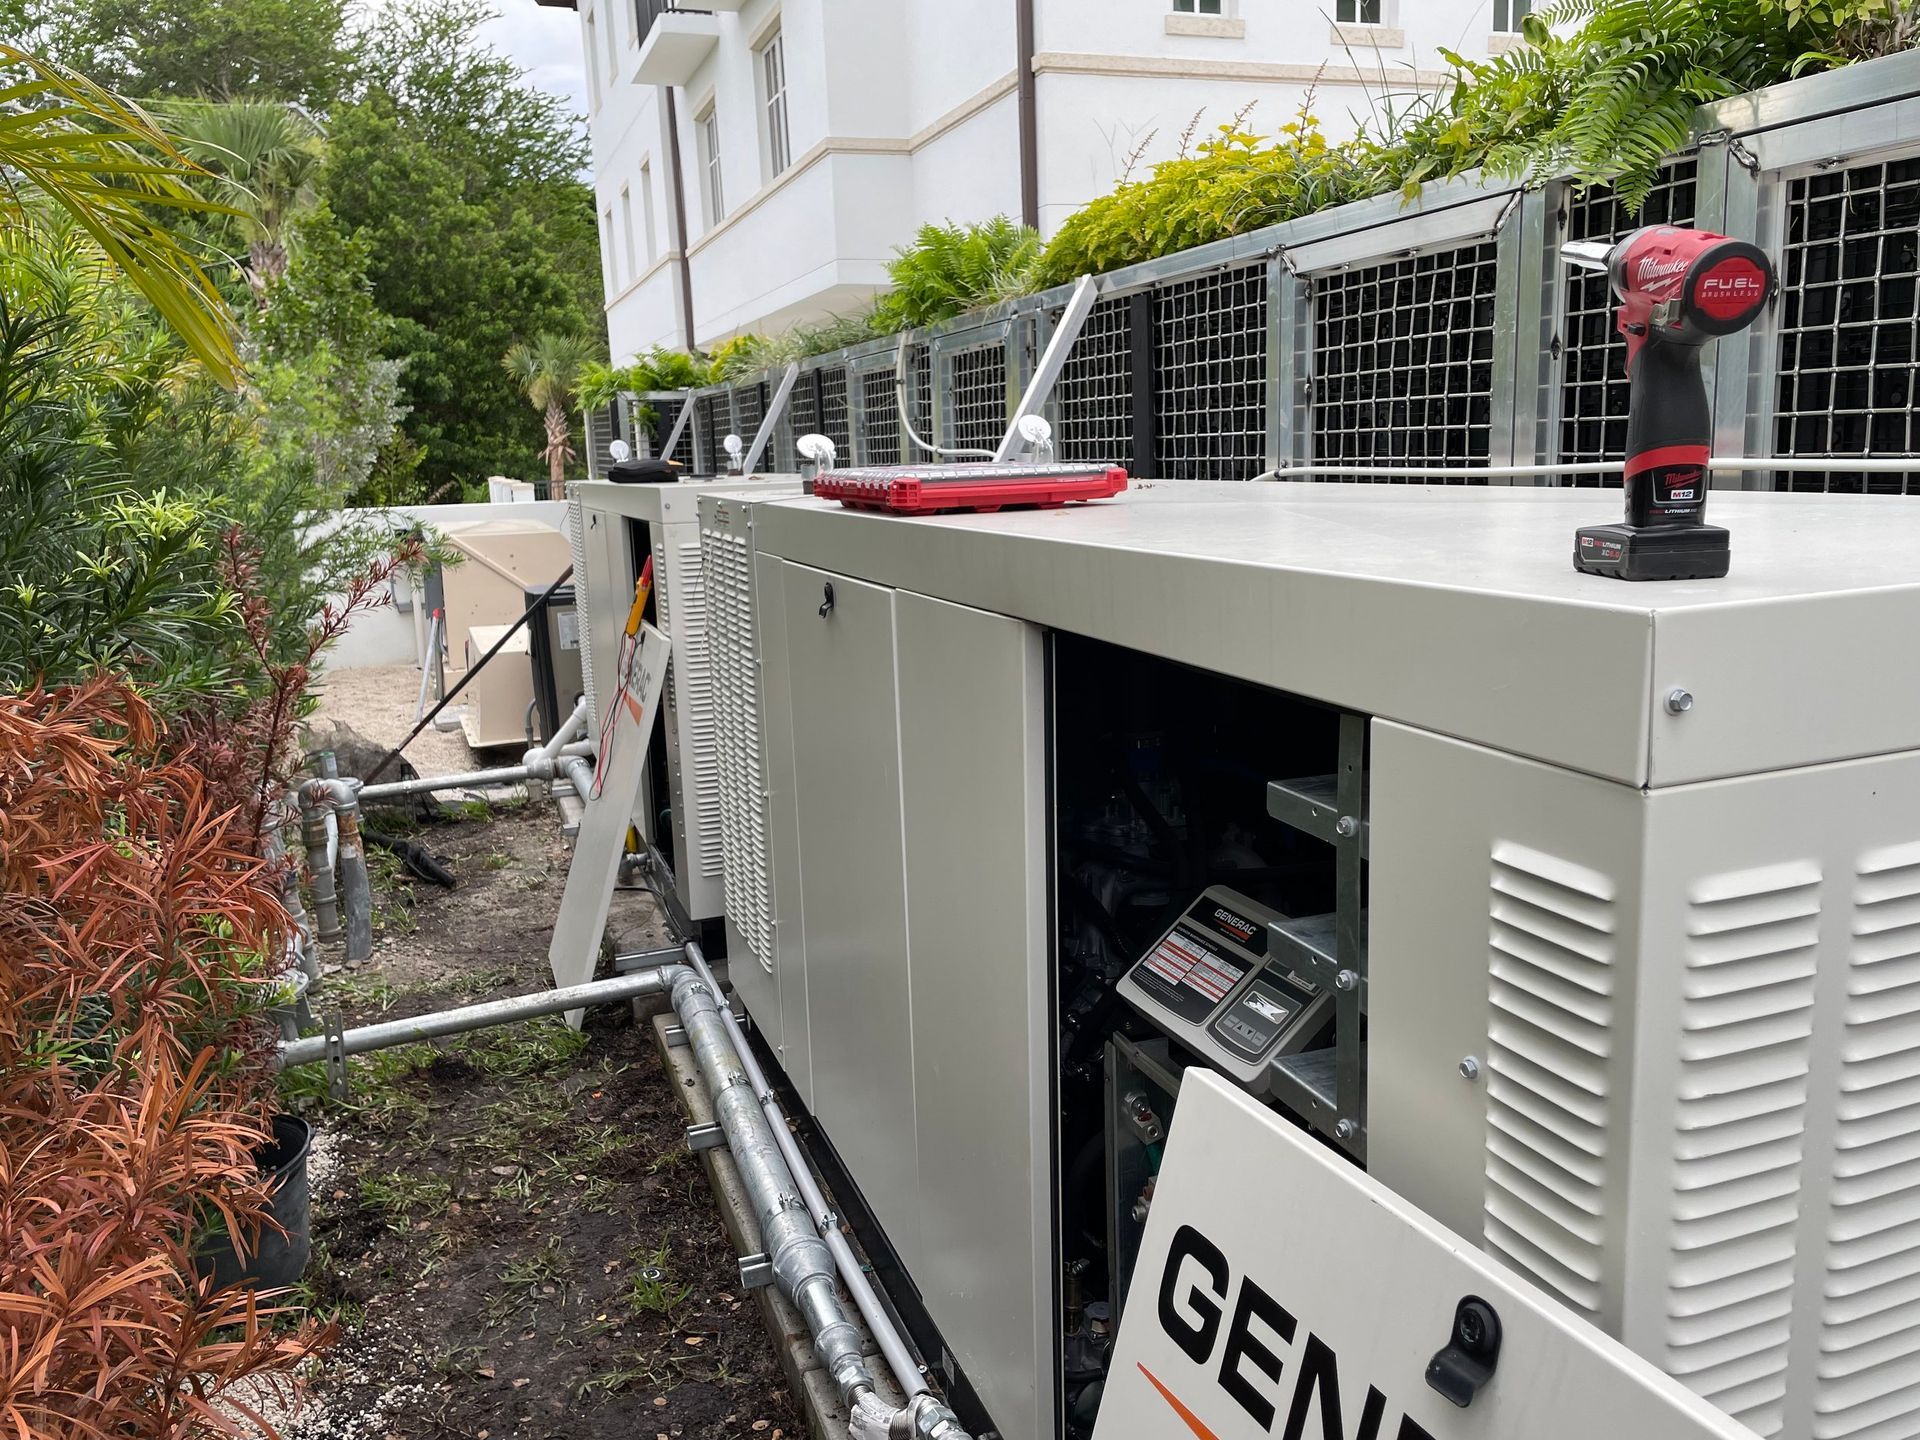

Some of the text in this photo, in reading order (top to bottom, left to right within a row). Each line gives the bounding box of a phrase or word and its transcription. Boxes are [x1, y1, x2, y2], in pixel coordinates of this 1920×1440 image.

[1637, 256, 1689, 282] Milwaukee
[1701, 290, 1759, 298] BRUSHLESS
[1703, 278, 1760, 289] FUEL
[1214, 908, 1257, 936] GENERAC
[1158, 1224, 1436, 1440] GEN
